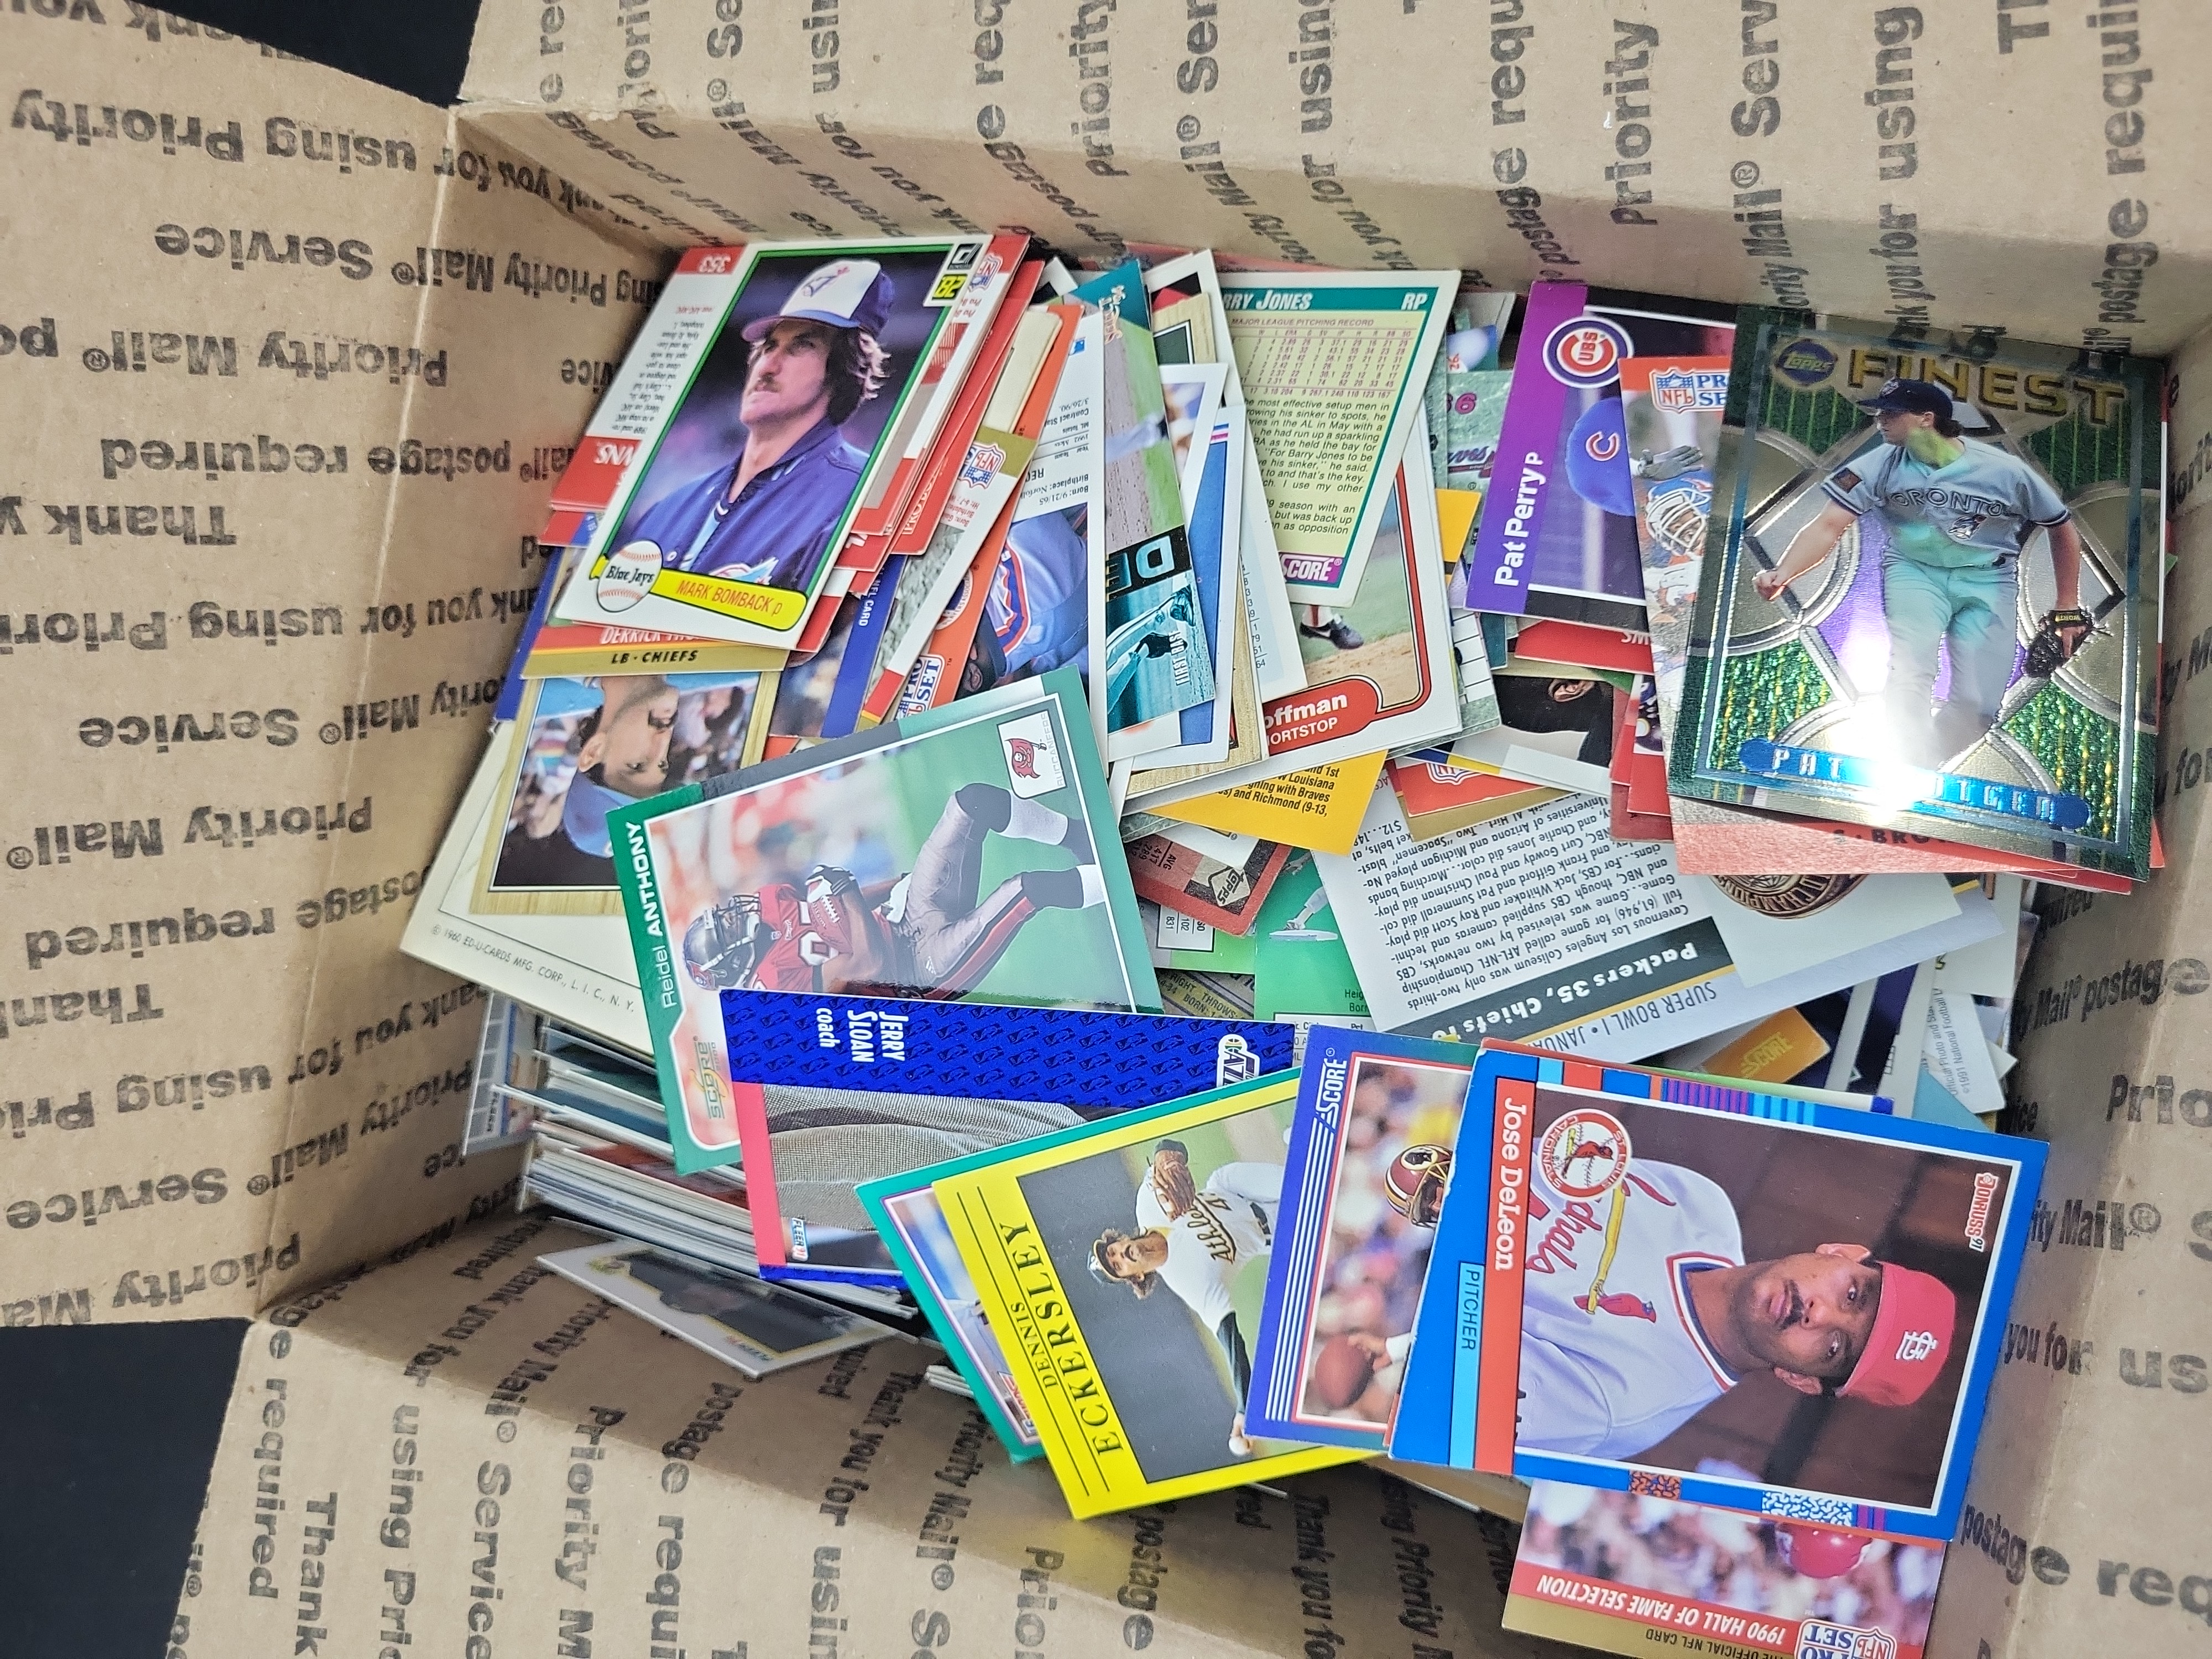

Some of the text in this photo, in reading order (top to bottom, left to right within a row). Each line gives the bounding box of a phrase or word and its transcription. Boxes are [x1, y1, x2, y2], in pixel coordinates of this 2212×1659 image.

[1069, 0, 1130, 176] Priority
[11, 90, 491, 191] for using Priority
[1603, 19, 1660, 226] Priority
[498, 160, 552, 199] you
[977, 104, 1099, 218] postage
[1301, 153, 1353, 208] for
[1864, 6, 1936, 300] you for using
[1492, 147, 1580, 269] postage
[155, 223, 373, 280] Service
[2091, 196, 2158, 324] postage
[503, 252, 607, 307] Priority
[1256, 289, 1428, 311] JONES RP
[1232, 318, 1374, 326] MAJOR LEAGUE PITCHING RECORD
[259, 332, 448, 387] Priority
[1848, 348, 2125, 425] FINEST
[1058, 408, 1089, 423] Contract
[1258, 400, 1280, 408] most
[1283, 400, 1322, 410] effective
[1326, 401, 1353, 412] setup
[1661, 389, 1693, 406] NFL
[101, 435, 510, 482] postage required
[1048, 473, 1089, 491] Birthplace:
[1289, 449, 1342, 461] Barry Jones
[1040, 485, 1089, 505] Born: 9/21/65
[1279, 502, 1338, 512] season with
[1337, 483, 1364, 493] other
[1889, 487, 2003, 517] ORONTO
[43, 504, 237, 545] Thank
[1299, 522, 1348, 535] opposition
[1495, 452, 1547, 586] Pat Perry P
[606, 565, 653, 587] Blue Jays
[676, 581, 711, 598] MARK
[712, 586, 771, 611] BOMBACK
[189, 587, 484, 646] you for using
[599, 629, 662, 645] DERRICK
[858, 599, 872, 628] CARD
[611, 650, 699, 664] LB CHIEFS
[916, 658, 941, 702] SET
[1168, 629, 1189, 686] FIRST BASE
[79, 708, 300, 753] Service
[1288, 772, 1334, 790] Louisiana
[1771, 749, 1843, 780] PAT
[1233, 788, 1329, 817] and Richmond (9-13,
[1276, 784, 1330, 802] with Braves
[184, 797, 373, 847] Priority
[1163, 854, 1177, 870] AVG
[25, 907, 275, 969] required
[625, 821, 677, 1009] Reidel ANTHONY
[1395, 901, 1592, 981] was televised two networks, CBS
[1400, 887, 1682, 996] full (61,946) for game called AFL-NFL Championship
[443, 928, 569, 987] 1960 ED-U-CARDS MFG. CORP.,
[1406, 902, 1689, 1011] Cavernous Los Angeles Coliseum was only two-thirds
[1461, 940, 1698, 1038] Packers 35, Chiefs
[1613, 979, 1717, 1031] SUPER BOWL
[1934, 996, 1952, 1029] Football
[2082, 957, 2210, 1023] postage
[816, 1008, 836, 1048] coach
[848, 1010, 875, 1063] SLOAN
[878, 1011, 909, 1062] JERRY
[1928, 1024, 1940, 1040] and
[1945, 1030, 1963, 1064] National
[117, 1010, 413, 1113] you for using
[1542, 1115, 1578, 1188] CARDINALS
[6, 1167, 228, 1229] Service
[1494, 1097, 1527, 1271] Jose DeLeon
[791, 1217, 805, 1247] FLEER
[111, 1232, 301, 1311] Priority
[1459, 1270, 1480, 1350] PITCHER
[1001, 1223, 1124, 1455] ECKERSLEY
[1011, 1302, 1058, 1390] DENNIS
[2004, 1321, 2094, 1376] you for
[662, 1381, 744, 1495] postage
[249, 1378, 288, 1599] required
[380, 1403, 423, 1549] using
[555, 1406, 626, 1590] Priority
[821, 1428, 884, 1527] you for
[465, 1460, 512, 1659] Service
[1960, 1503, 2070, 1586] postage
[294, 1491, 338, 1656] Thank
[1537, 1574, 1787, 1645] 1990 HALL OF FAME SELECTION
[1804, 1624, 1854, 1644] SET
[1646, 1629, 1704, 1651] NFL CARD
